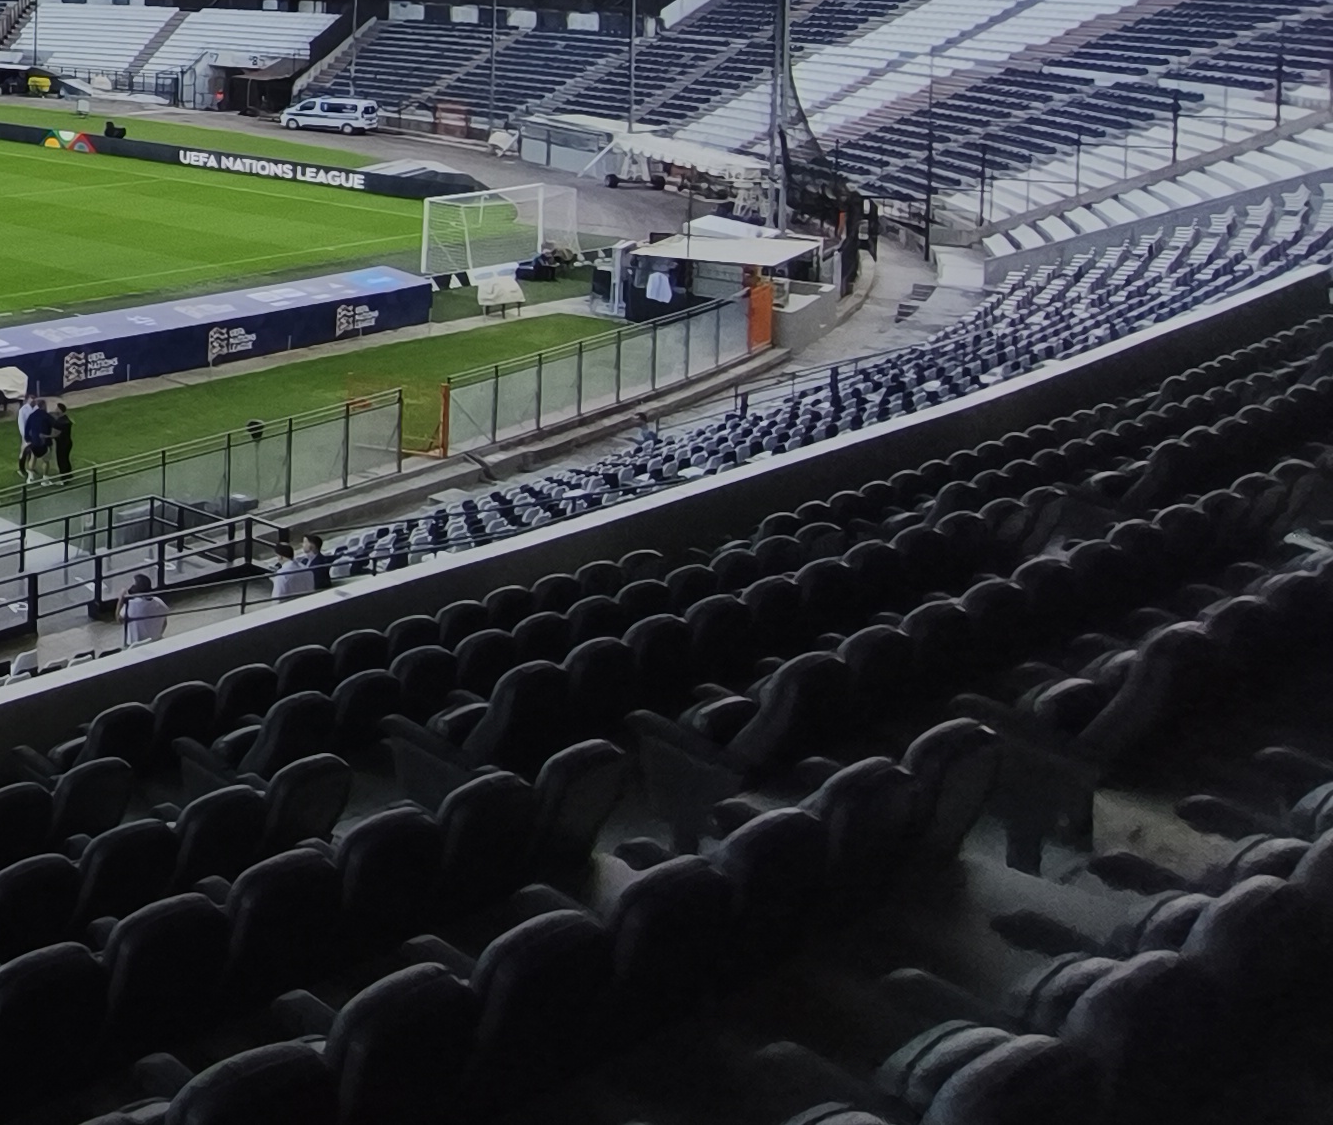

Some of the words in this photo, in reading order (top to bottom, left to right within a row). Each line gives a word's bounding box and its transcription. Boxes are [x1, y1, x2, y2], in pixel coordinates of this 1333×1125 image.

[179, 149, 219, 169] UEFA
[221, 155, 294, 179] NATIONS
[296, 165, 365, 190] LEAGUE
